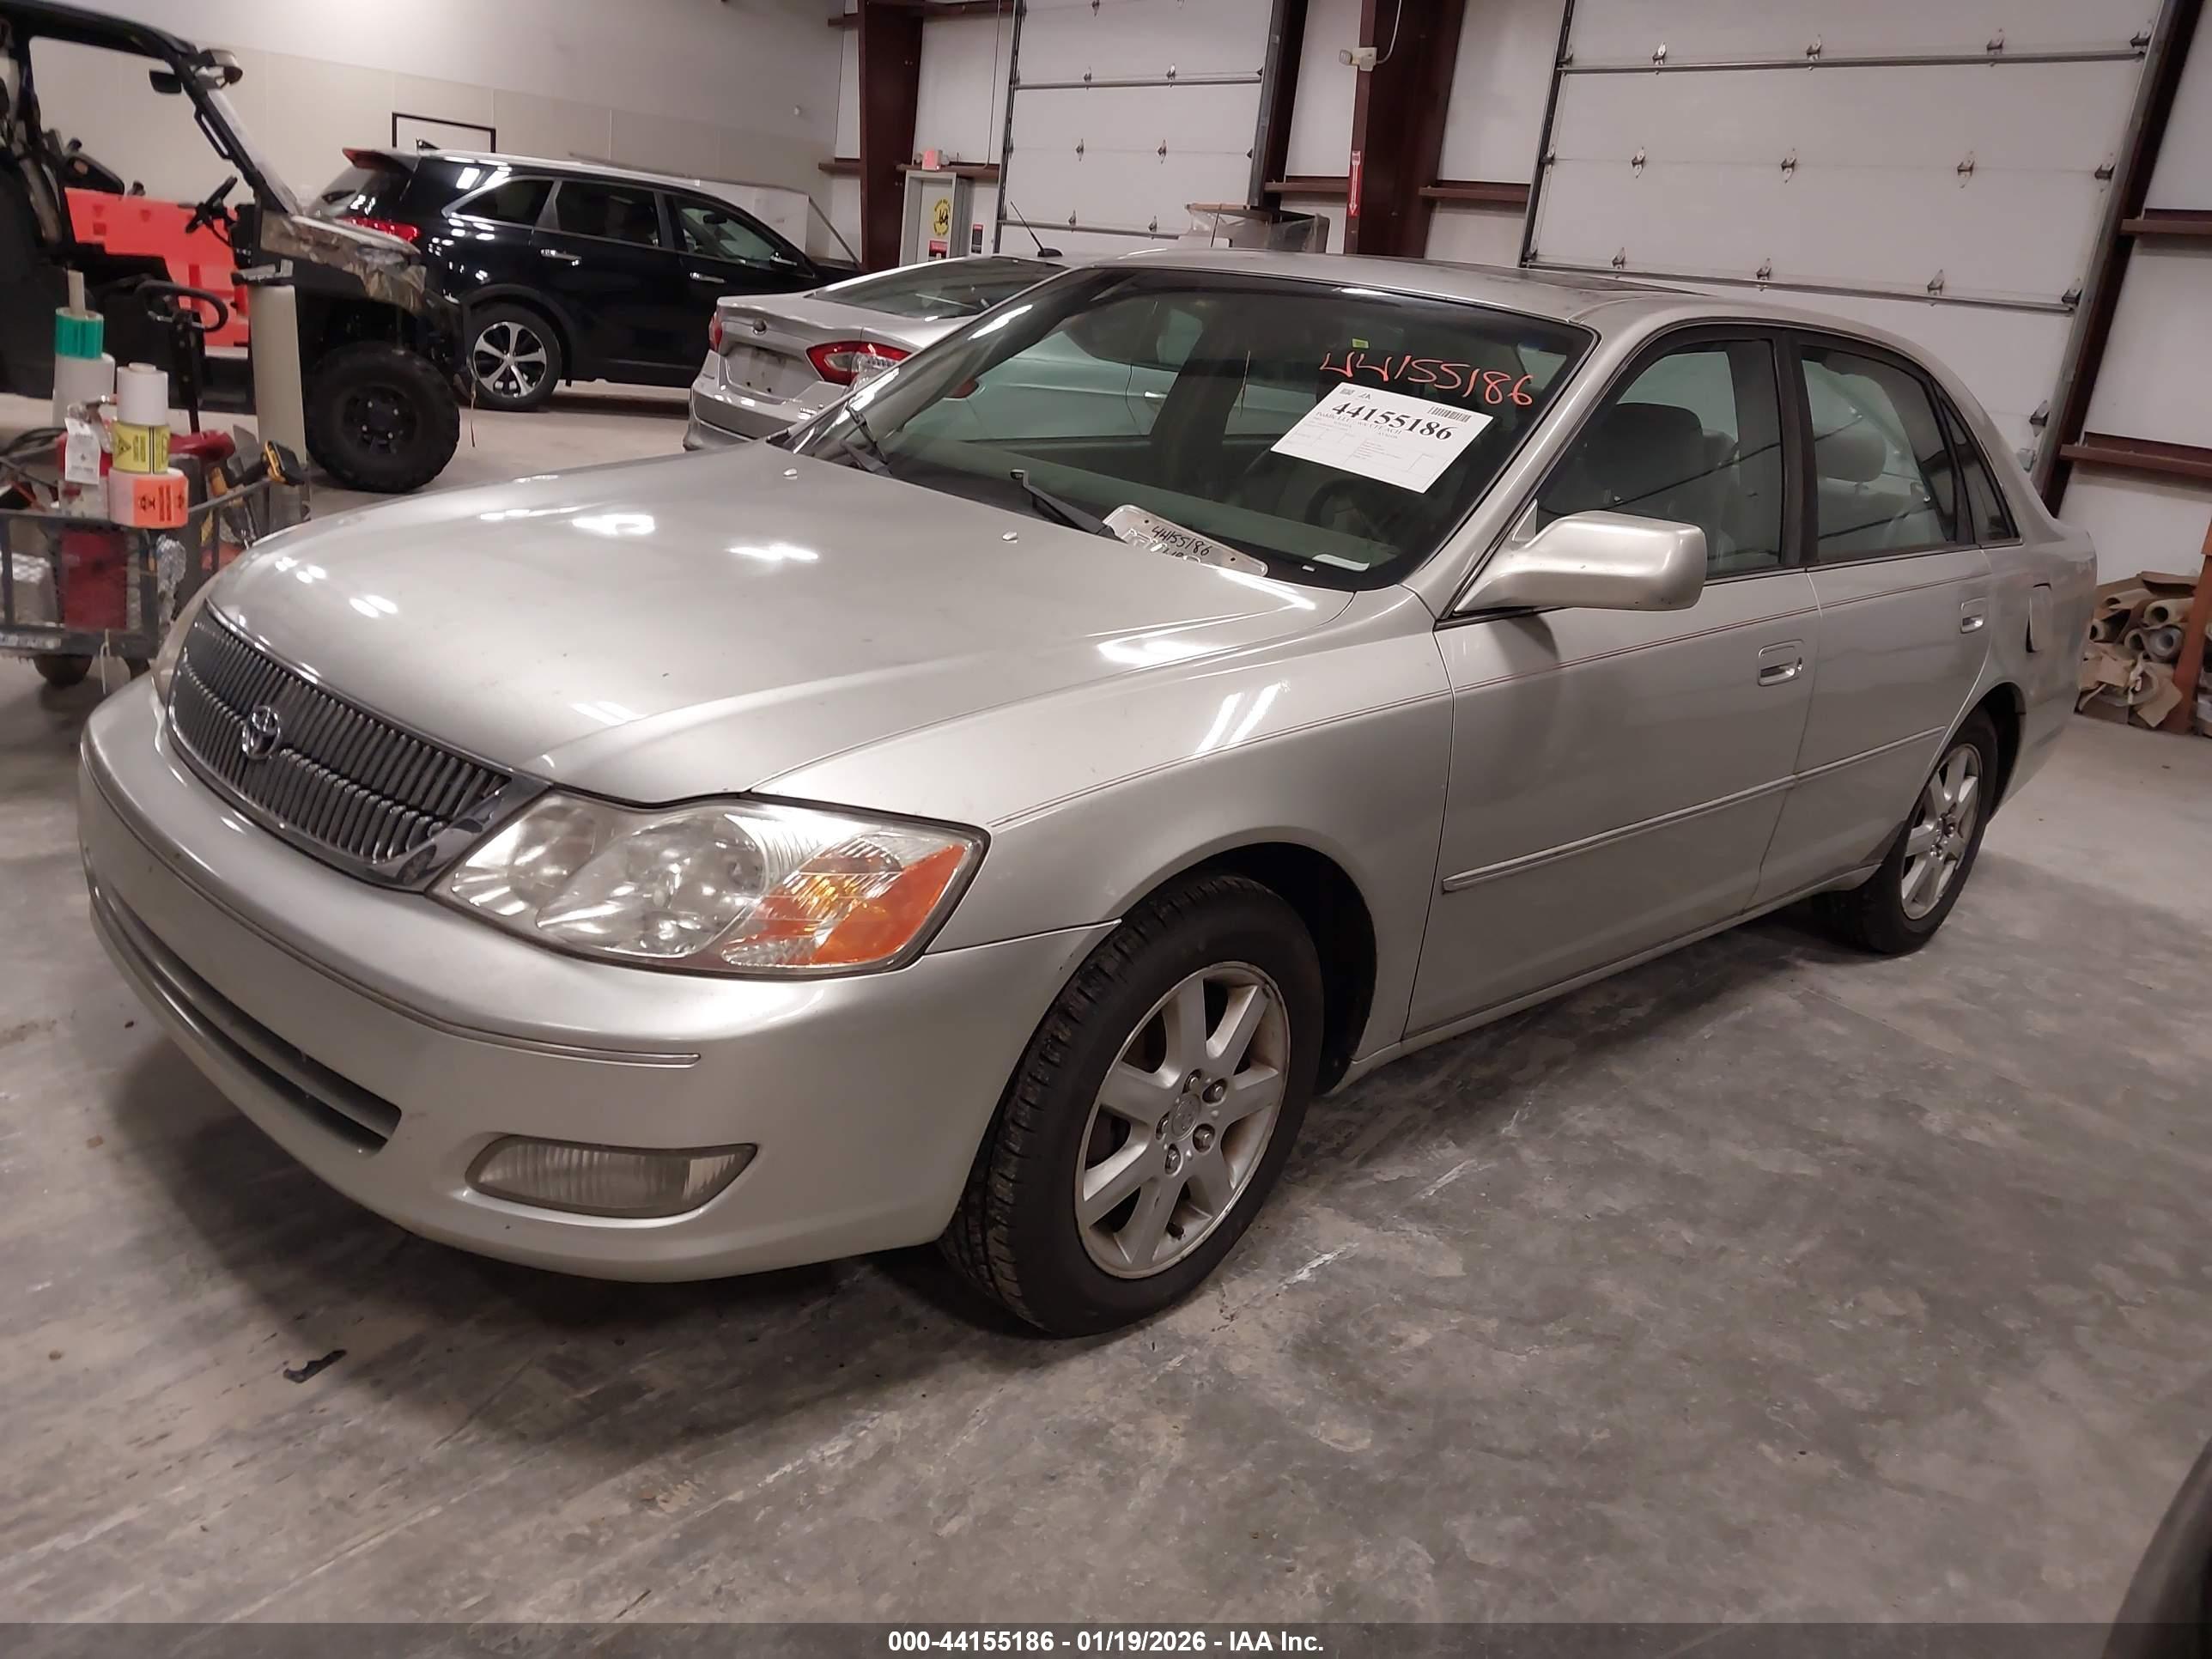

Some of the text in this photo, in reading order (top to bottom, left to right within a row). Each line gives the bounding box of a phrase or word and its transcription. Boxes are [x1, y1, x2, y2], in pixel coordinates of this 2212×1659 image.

[1319, 350, 1534, 406] 44155186
[1331, 402, 1458, 441] 44155186
[1152, 526, 1212, 556] 44155186
